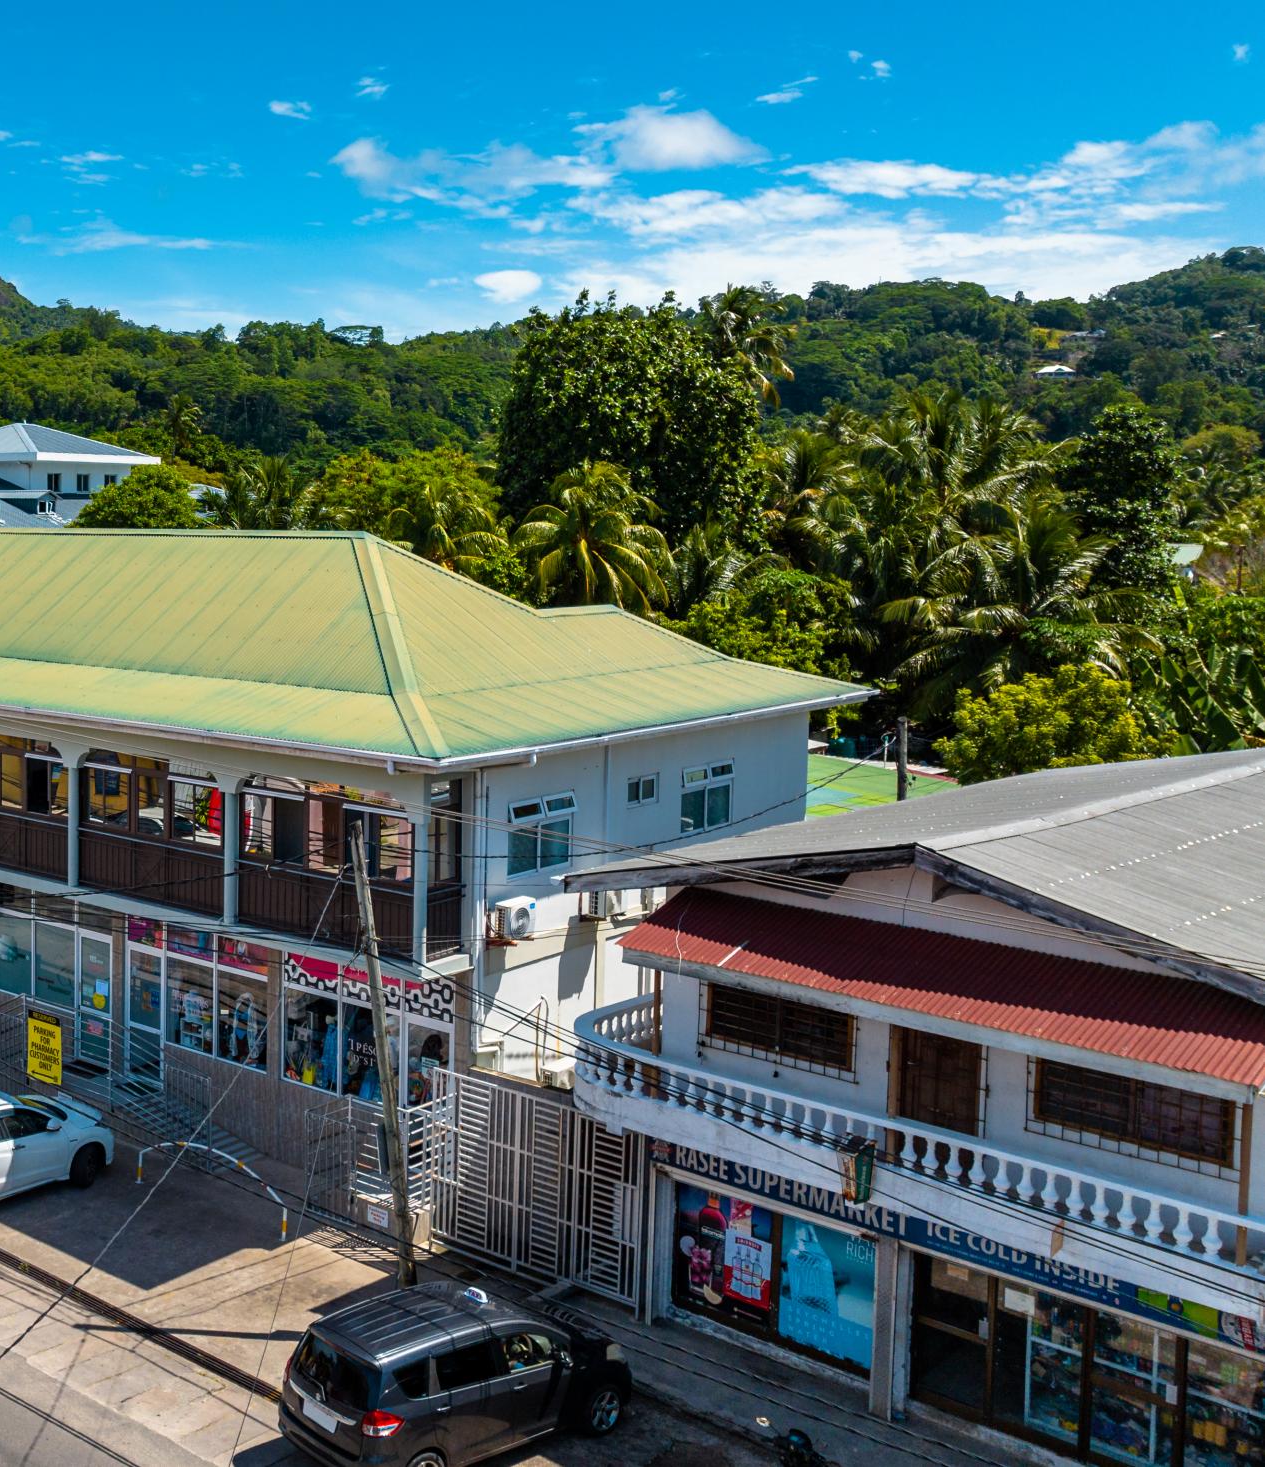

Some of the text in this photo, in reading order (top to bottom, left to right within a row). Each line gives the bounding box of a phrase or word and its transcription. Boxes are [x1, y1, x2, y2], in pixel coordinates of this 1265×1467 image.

[32, 1011, 57, 1023] RESERVED
[33, 1025, 56, 1039] PARKING
[40, 1035, 51, 1046] FOR
[29, 1049, 60, 1065] CUSTOMERS
[31, 1041, 60, 1057] PHARMACY
[38, 1061, 53, 1072] ONLY
[675, 1145, 729, 1180] RASEE
[846, 1240, 874, 1263] RICH
[926, 1220, 961, 1246] ICE
[966, 1232, 1028, 1265] COLD
[1035, 1254, 1121, 1295] INSIDE
